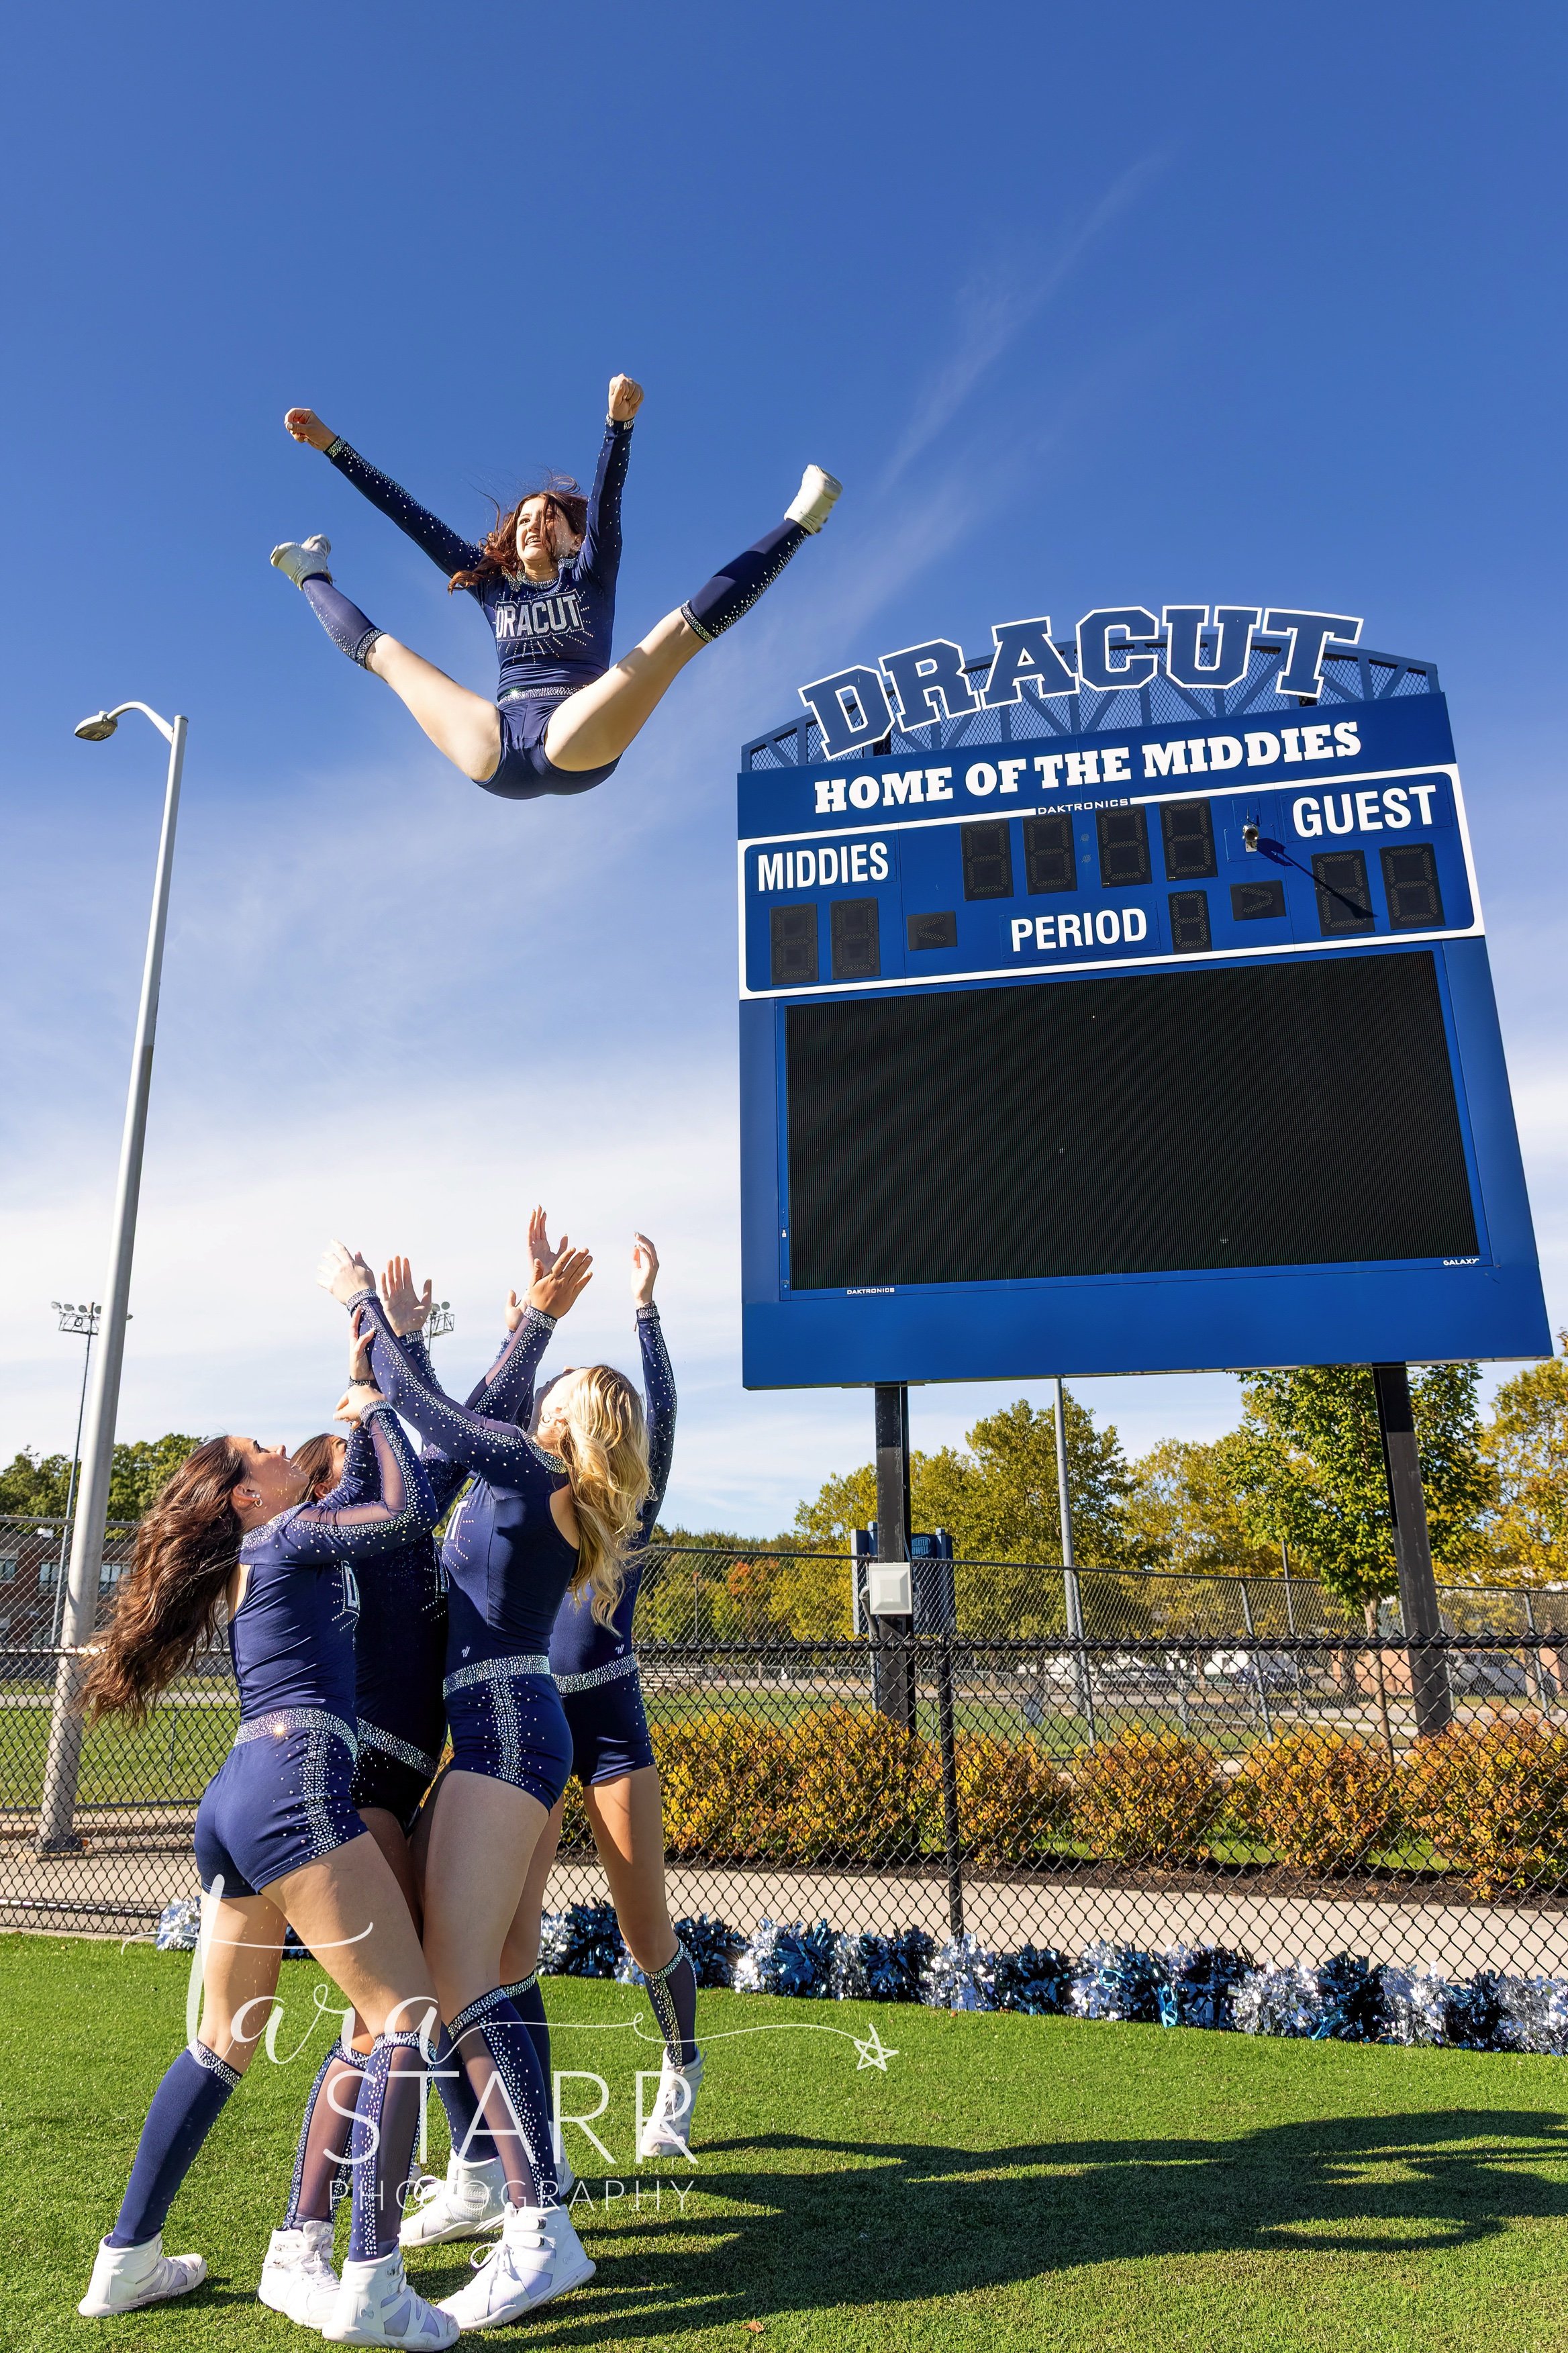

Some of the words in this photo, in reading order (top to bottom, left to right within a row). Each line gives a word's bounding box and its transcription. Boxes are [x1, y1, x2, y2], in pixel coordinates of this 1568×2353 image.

[495, 594, 580, 638] DRACUT
[797, 605, 1365, 761] DRACUT
[814, 767, 953, 814] HOME
[965, 758, 1027, 796] OF
[1034, 747, 1132, 789] THE
[1142, 721, 1361, 778] MIDDIES
[1038, 798, 1128, 815] DAKTRONICS
[1293, 785, 1436, 838] GUEST
[758, 842, 889, 892] MIDDIES
[1011, 908, 1147, 952] PERIOD
[1443, 1258, 1479, 1266] GALAXY
[846, 1287, 895, 1295] DAKTRONICS
[912, 1539, 928, 1547] REATER
[912, 1546, 928, 1555] OWELL
